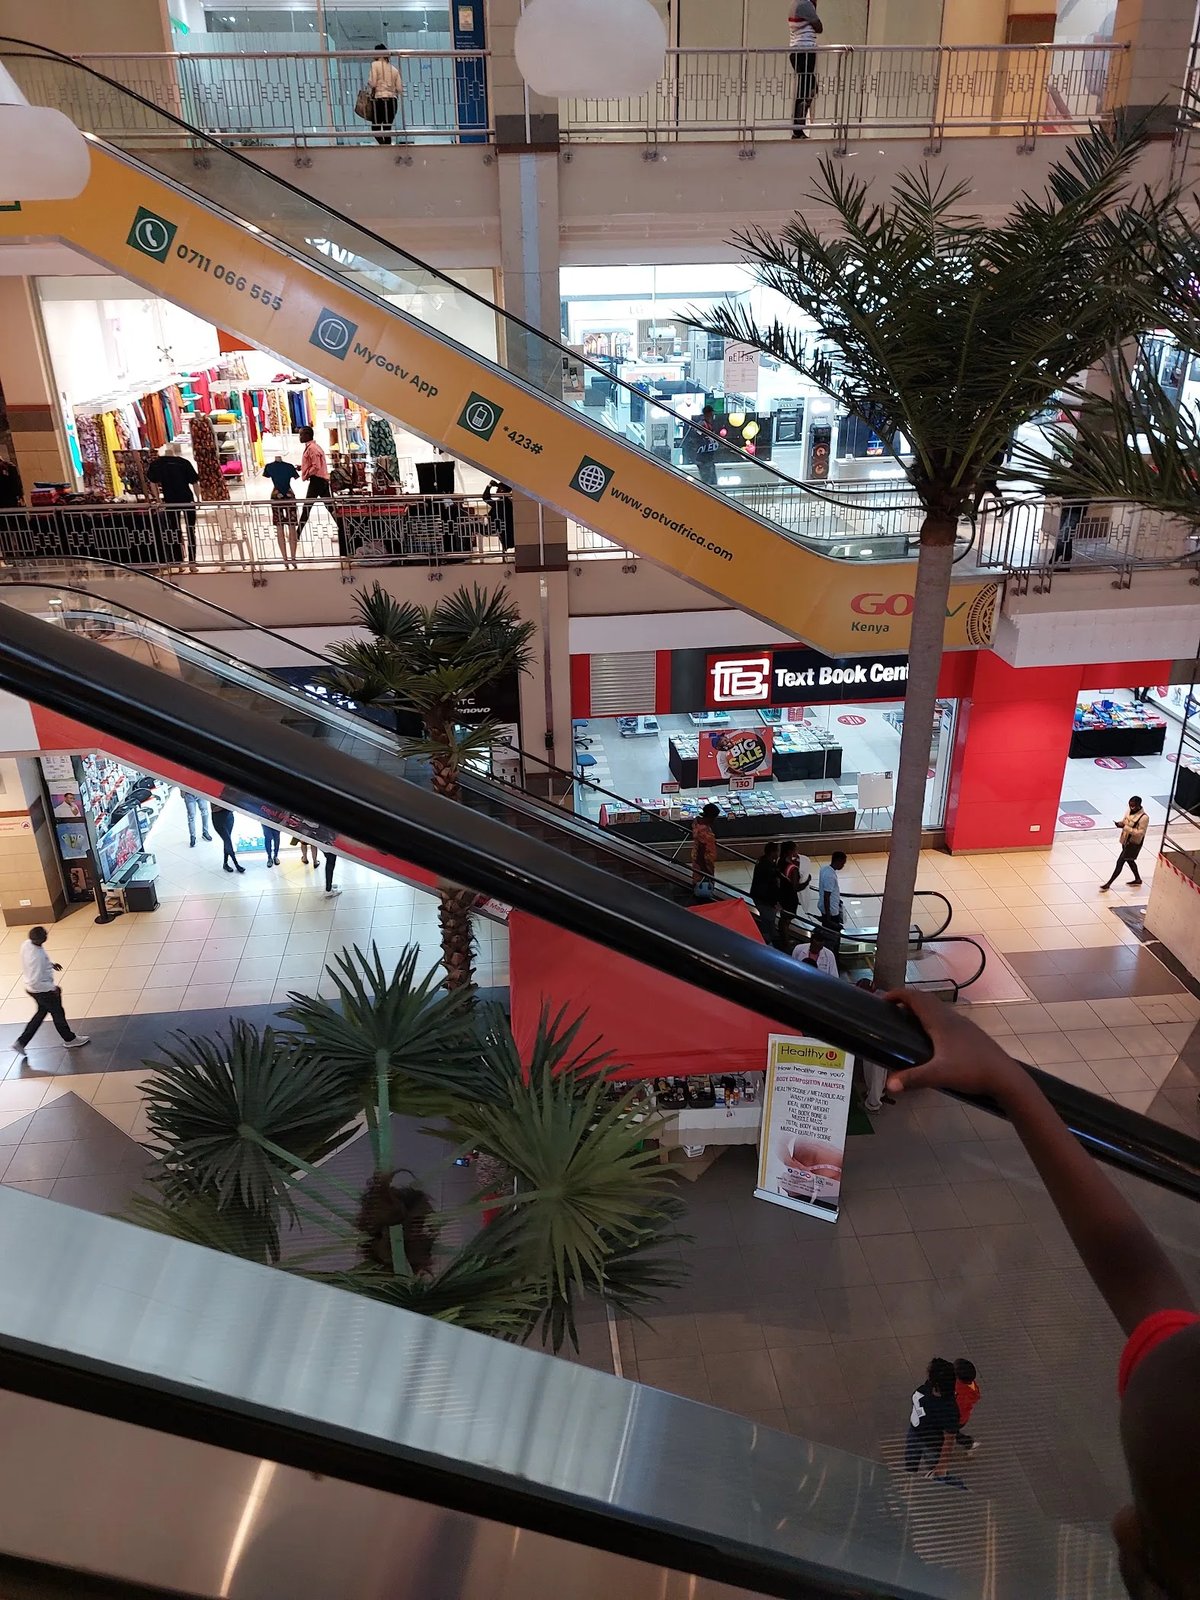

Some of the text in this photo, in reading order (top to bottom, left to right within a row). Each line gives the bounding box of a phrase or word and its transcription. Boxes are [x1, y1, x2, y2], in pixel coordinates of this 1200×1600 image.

[176, 244, 283, 310] 0711 066 555
[353, 342, 438, 398] MyGotv App
[610, 487, 733, 561] www.gotvafrica.com
[851, 621, 890, 634] Kenya
[775, 668, 815, 687] Text
[819, 664, 868, 685] Book
[728, 745, 764, 769] SALE
[731, 738, 756, 758] BIG
[781, 1046, 824, 1059] Healthy
[794, 1065, 815, 1074] healthy
